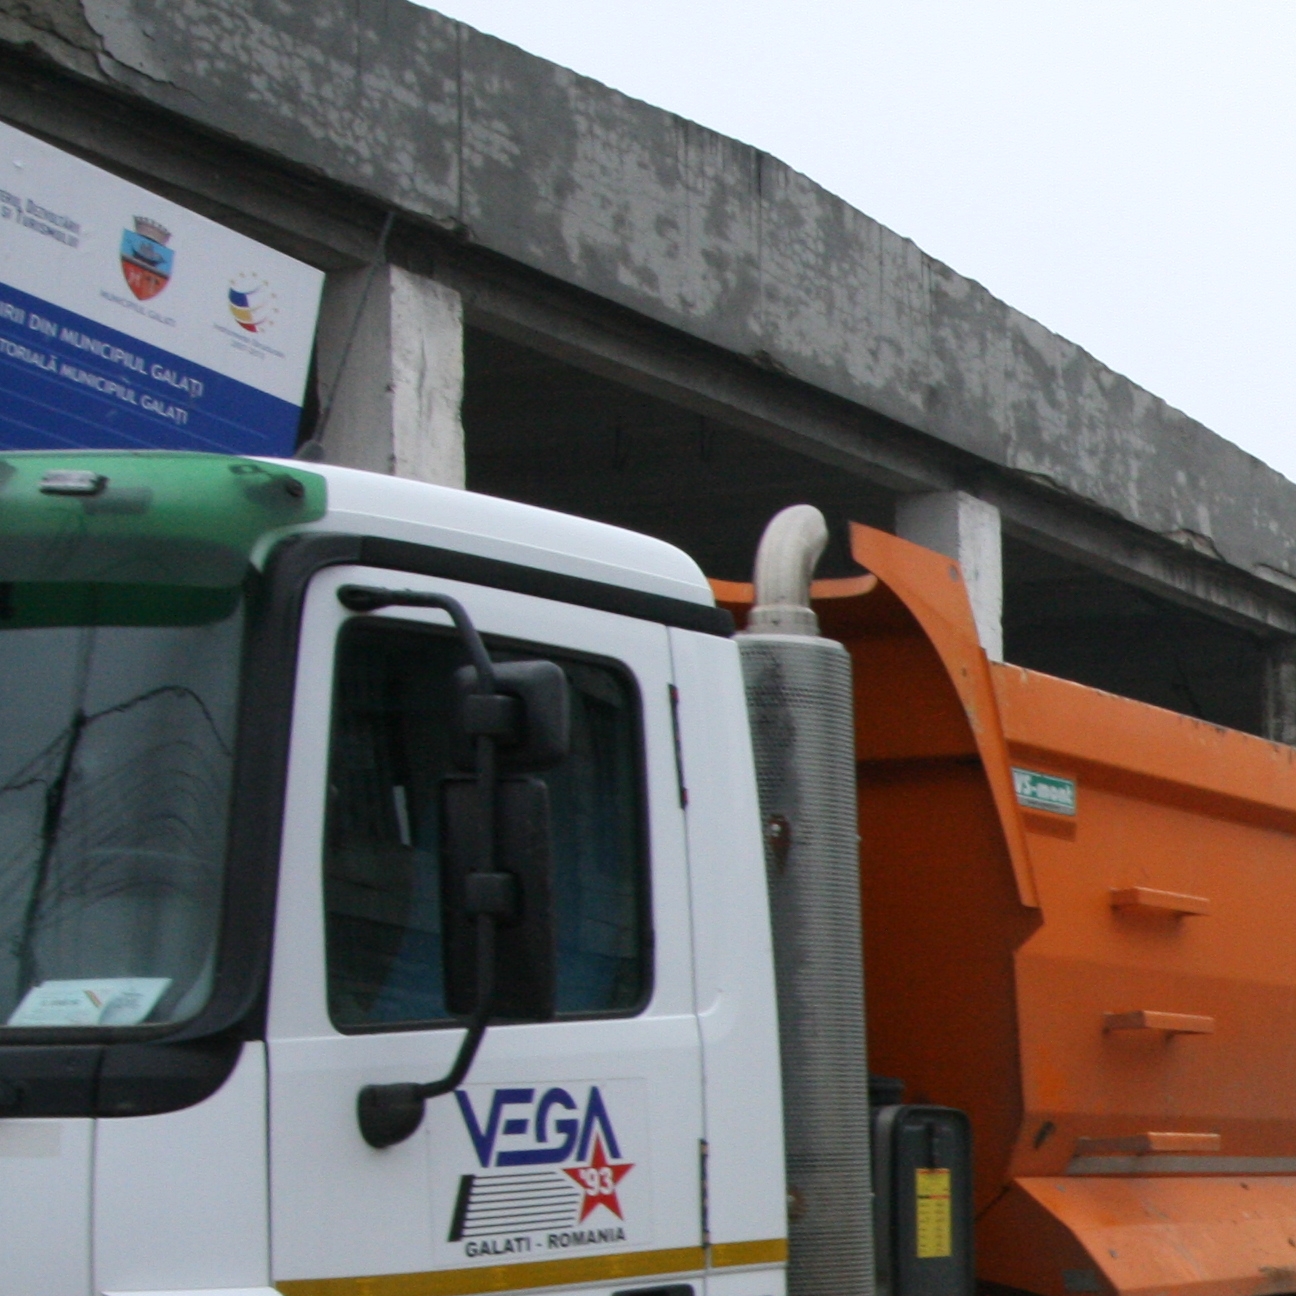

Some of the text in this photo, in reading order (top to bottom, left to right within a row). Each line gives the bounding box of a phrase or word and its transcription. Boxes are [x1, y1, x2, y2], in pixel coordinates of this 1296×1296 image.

[29, 313, 58, 338] DIN
[60, 327, 148, 375] MUNICIPIUL
[59, 363, 137, 405] MUNICIPIUL
[454, 1086, 622, 1168] VEGA
[465, 1236, 532, 1258] GALATI
[548, 1227, 626, 1249] ROMANIA
